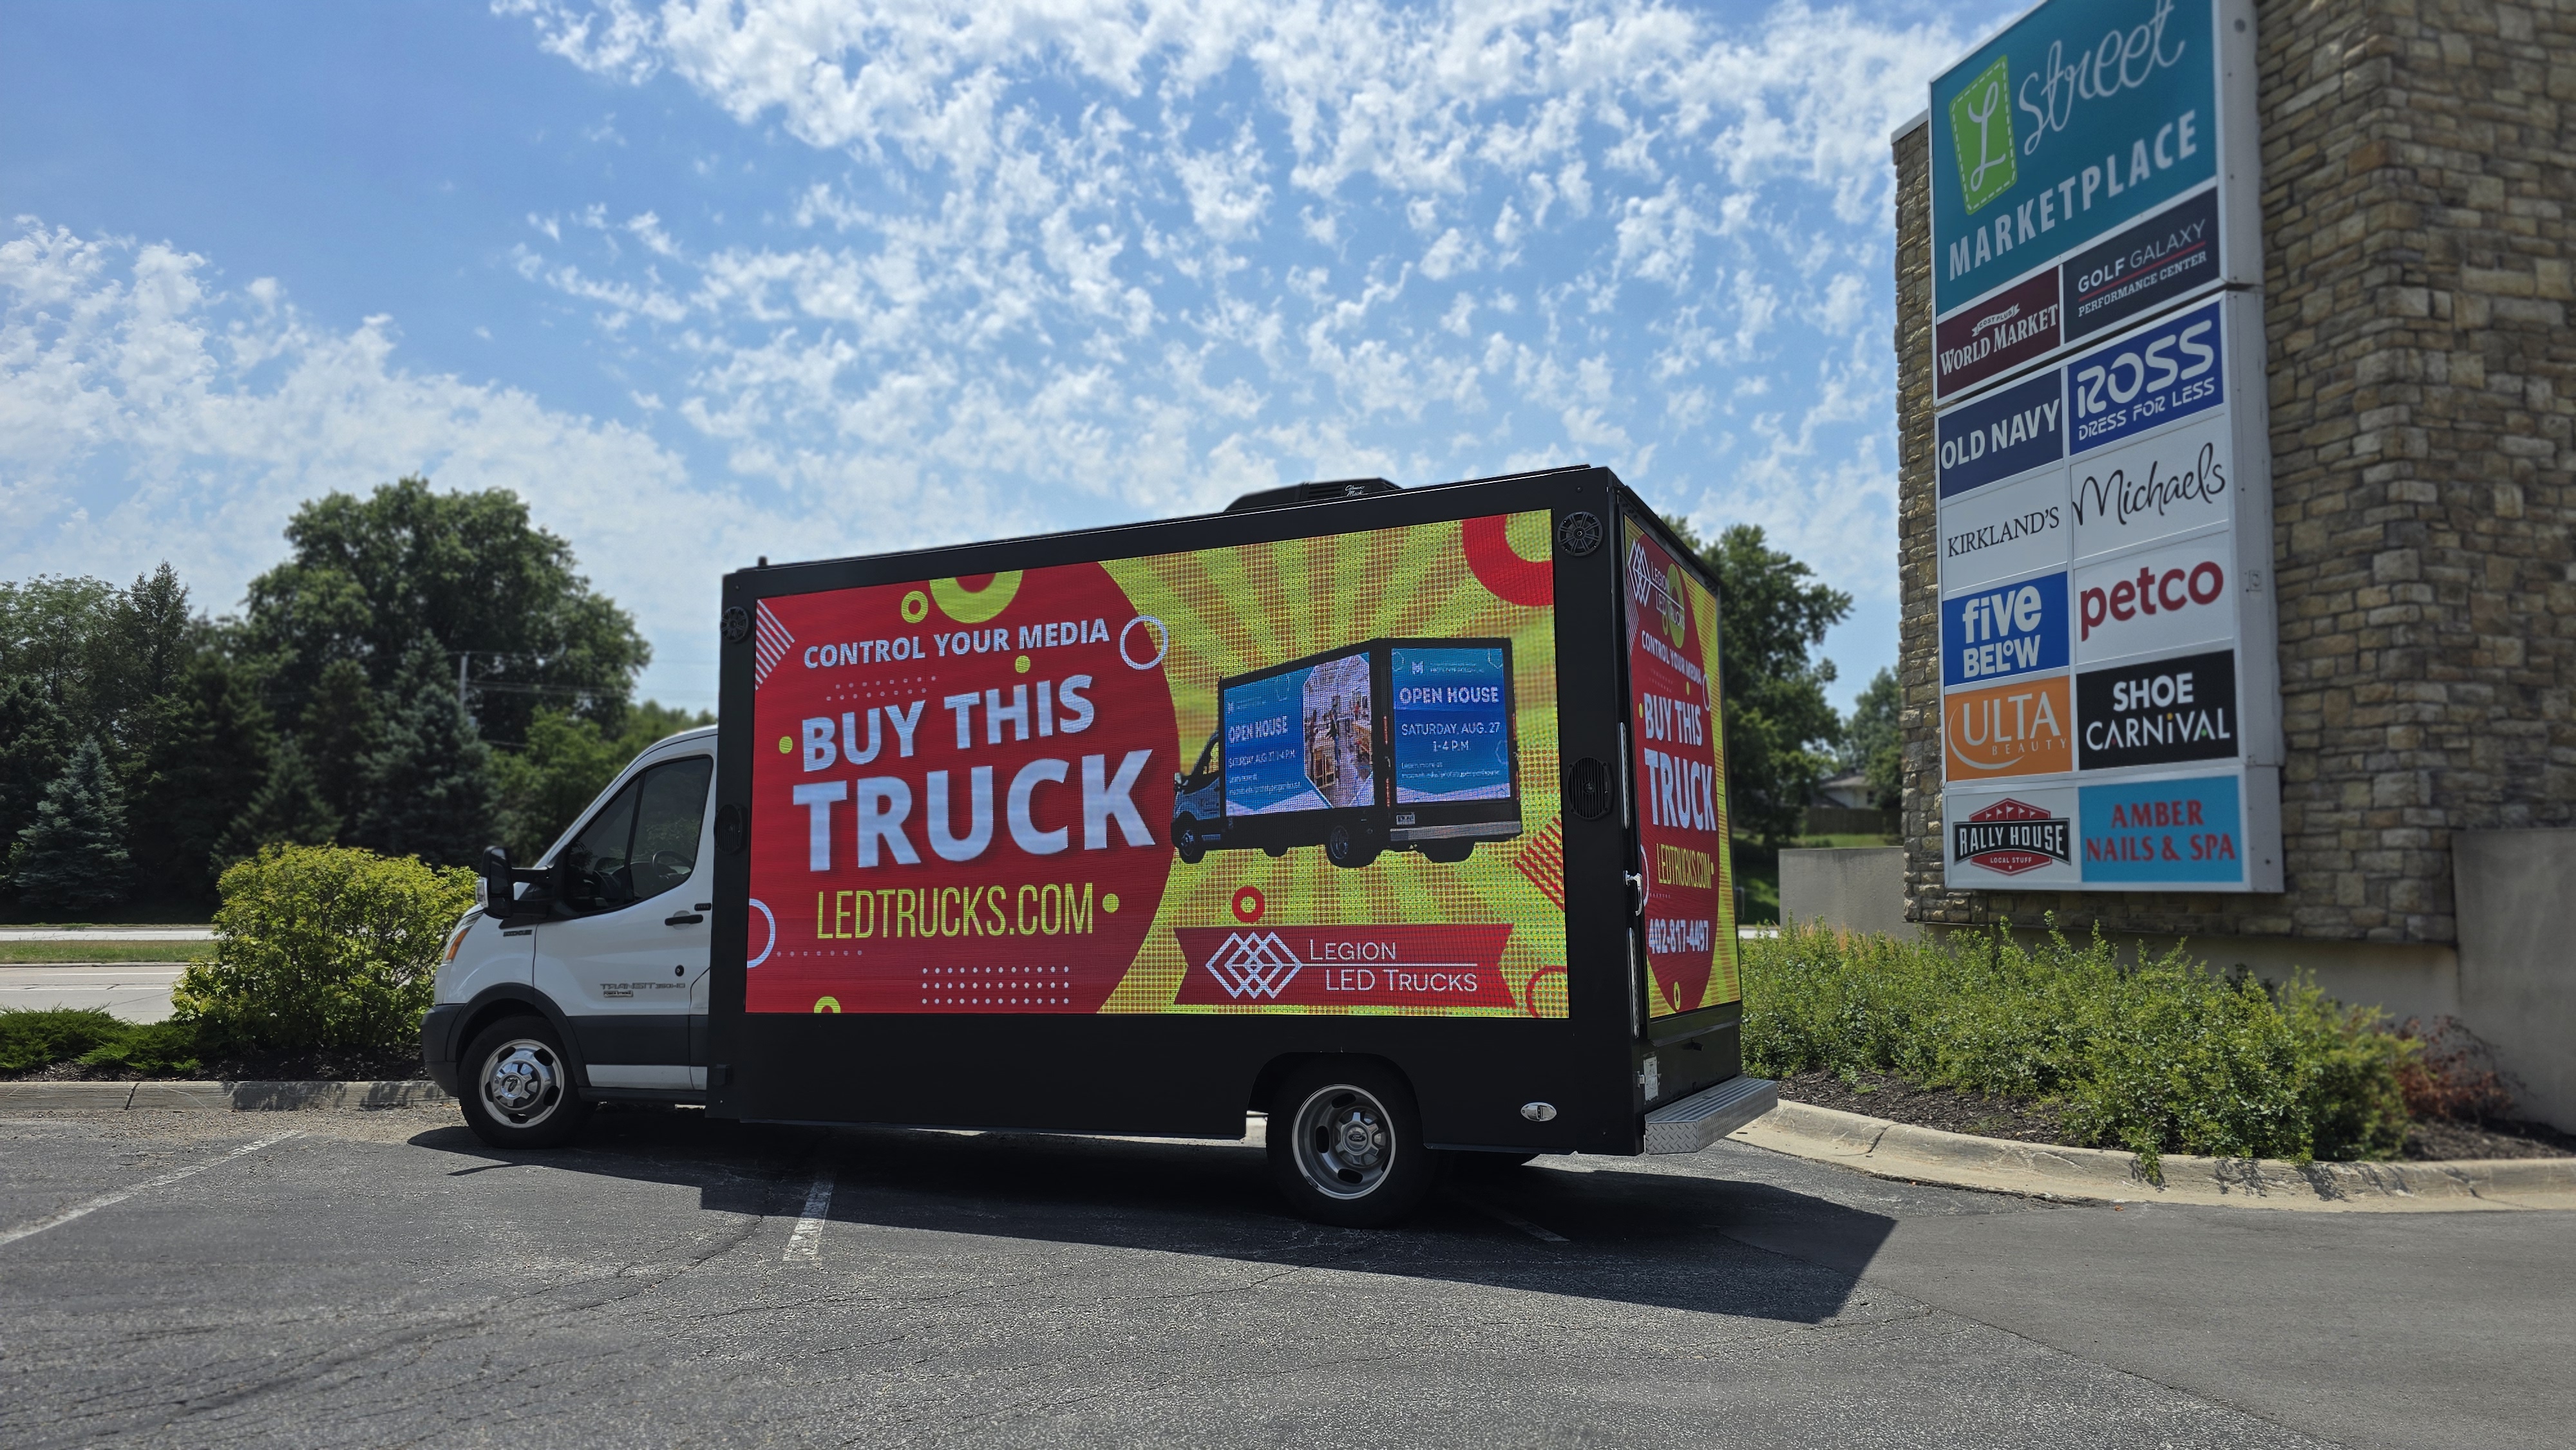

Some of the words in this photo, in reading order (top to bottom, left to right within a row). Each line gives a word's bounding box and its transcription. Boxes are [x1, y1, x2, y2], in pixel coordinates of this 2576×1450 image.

[1949, 110, 2197, 281] MARKETPLACE
[2078, 258, 2125, 292] GOLF
[2130, 219, 2206, 268] GALAXY
[2078, 270, 2157, 317] PERFORMANCE
[2160, 251, 2207, 281] CENTER
[1940, 338, 1990, 376] WORLD
[1993, 303, 2059, 352] MARKET
[1978, 315, 1996, 328] COST
[1996, 309, 2013, 323] PLUS
[2078, 319, 2214, 419] ROSS
[1940, 429, 1985, 469] OLD
[1991, 399, 2060, 453] NAVY
[2079, 409, 2126, 441] DRESS
[2133, 398, 2165, 421] FOR
[2172, 377, 2215, 407] LESS
[2072, 442, 2226, 525] Michaels
[1947, 506, 2060, 558] KIRKLAND'S
[1655, 590, 1667, 616] LED
[1962, 585, 2042, 643] five
[2080, 561, 2224, 642] petco
[803, 636, 925, 670] CONTROL
[934, 628, 1010, 657] YOUR
[1018, 618, 1110, 650] MEDIA
[1642, 630, 1670, 664] CONTROL
[1670, 648, 1685, 673] YOUR
[1685, 659, 1702, 685] MEDIA
[1964, 634, 2041, 678] BELOW
[1399, 687, 1443, 704] OPEN
[1447, 686, 1499, 703] HOUSE
[1964, 691, 2061, 746] ULTA
[2113, 672, 2193, 711] SHOE
[802, 700, 925, 772] BUY
[943, 674, 1095, 749] THIS
[1433, 740, 1449, 752] 1-4
[1489, 721, 1501, 733] 27
[1643, 692, 1671, 742] BUY
[1674, 699, 1703, 746] THIS
[1992, 737, 2067, 756] BEAUTY
[793, 749, 1155, 872] TRUCK
[1643, 748, 1716, 831] TRUCK
[2111, 800, 2204, 829] AMBER
[1656, 842, 1712, 889] LEDTRUCKS.COM
[1959, 826, 2003, 856] RALLY
[2010, 825, 2064, 856] HOUSE
[2086, 835, 2154, 862] NAILS
[2161, 836, 2181, 862] &
[2190, 834, 2236, 861] SPA
[817, 882, 1094, 939] LEDTRUCKS.COM
[1647, 918, 1709, 955] 402-817-4497
[1325, 969, 1375, 992] LED
